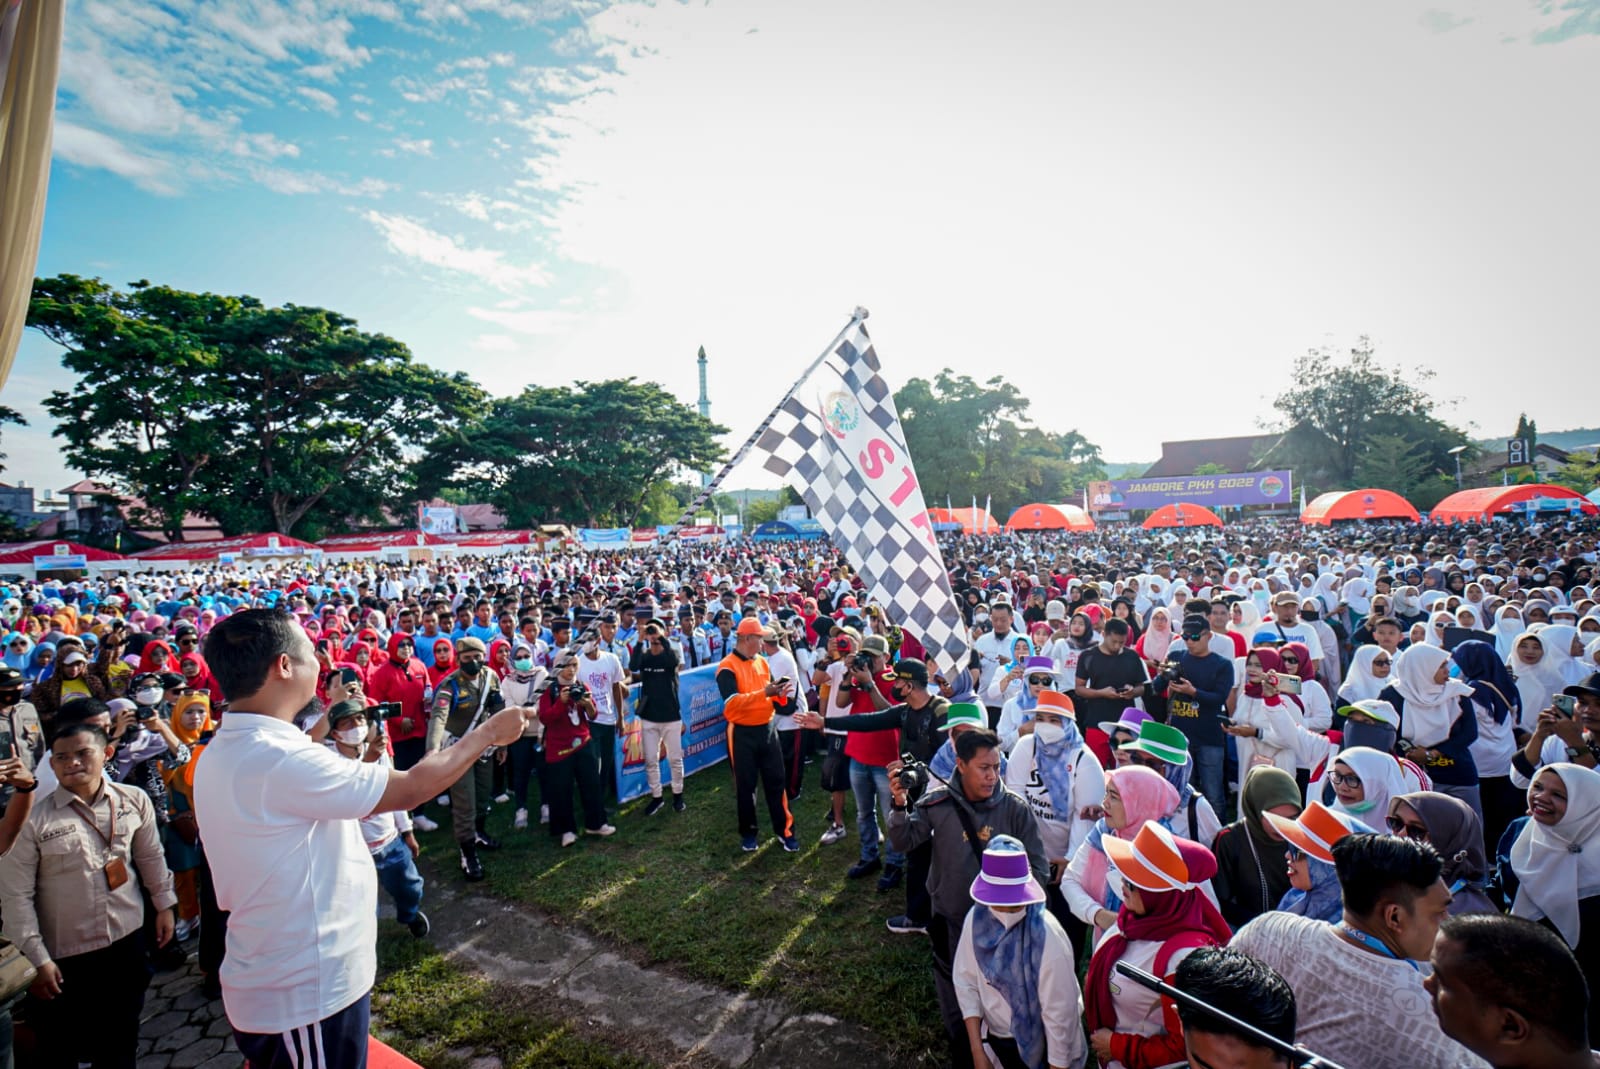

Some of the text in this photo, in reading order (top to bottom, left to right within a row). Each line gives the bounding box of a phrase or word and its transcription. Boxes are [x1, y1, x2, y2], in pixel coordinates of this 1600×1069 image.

[1127, 477, 1255, 493] JAMBORE PKK 2022
